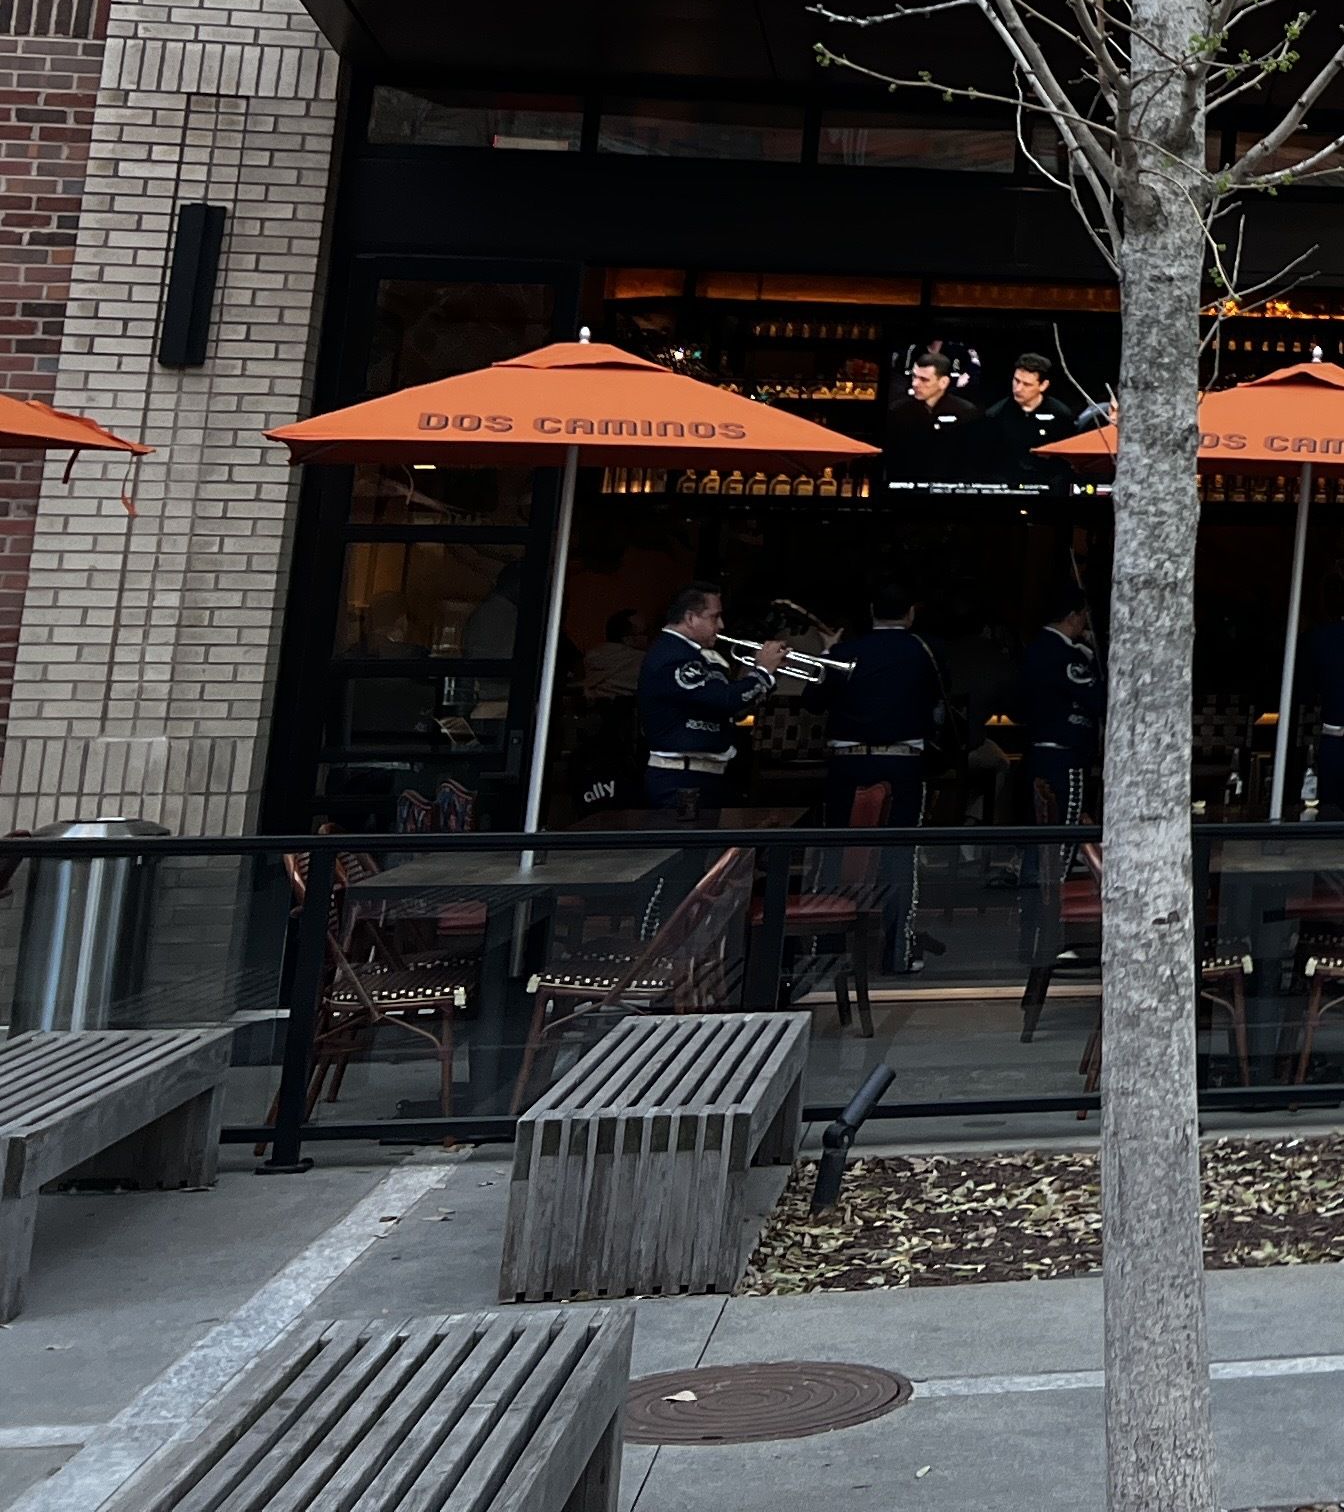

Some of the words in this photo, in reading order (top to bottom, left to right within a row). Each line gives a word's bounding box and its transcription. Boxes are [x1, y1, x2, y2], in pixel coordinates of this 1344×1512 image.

[418, 412, 514, 433] DOS
[533, 416, 747, 439] CAMINOS
[1198, 432, 1247, 450] OS
[584, 780, 615, 803] ally
